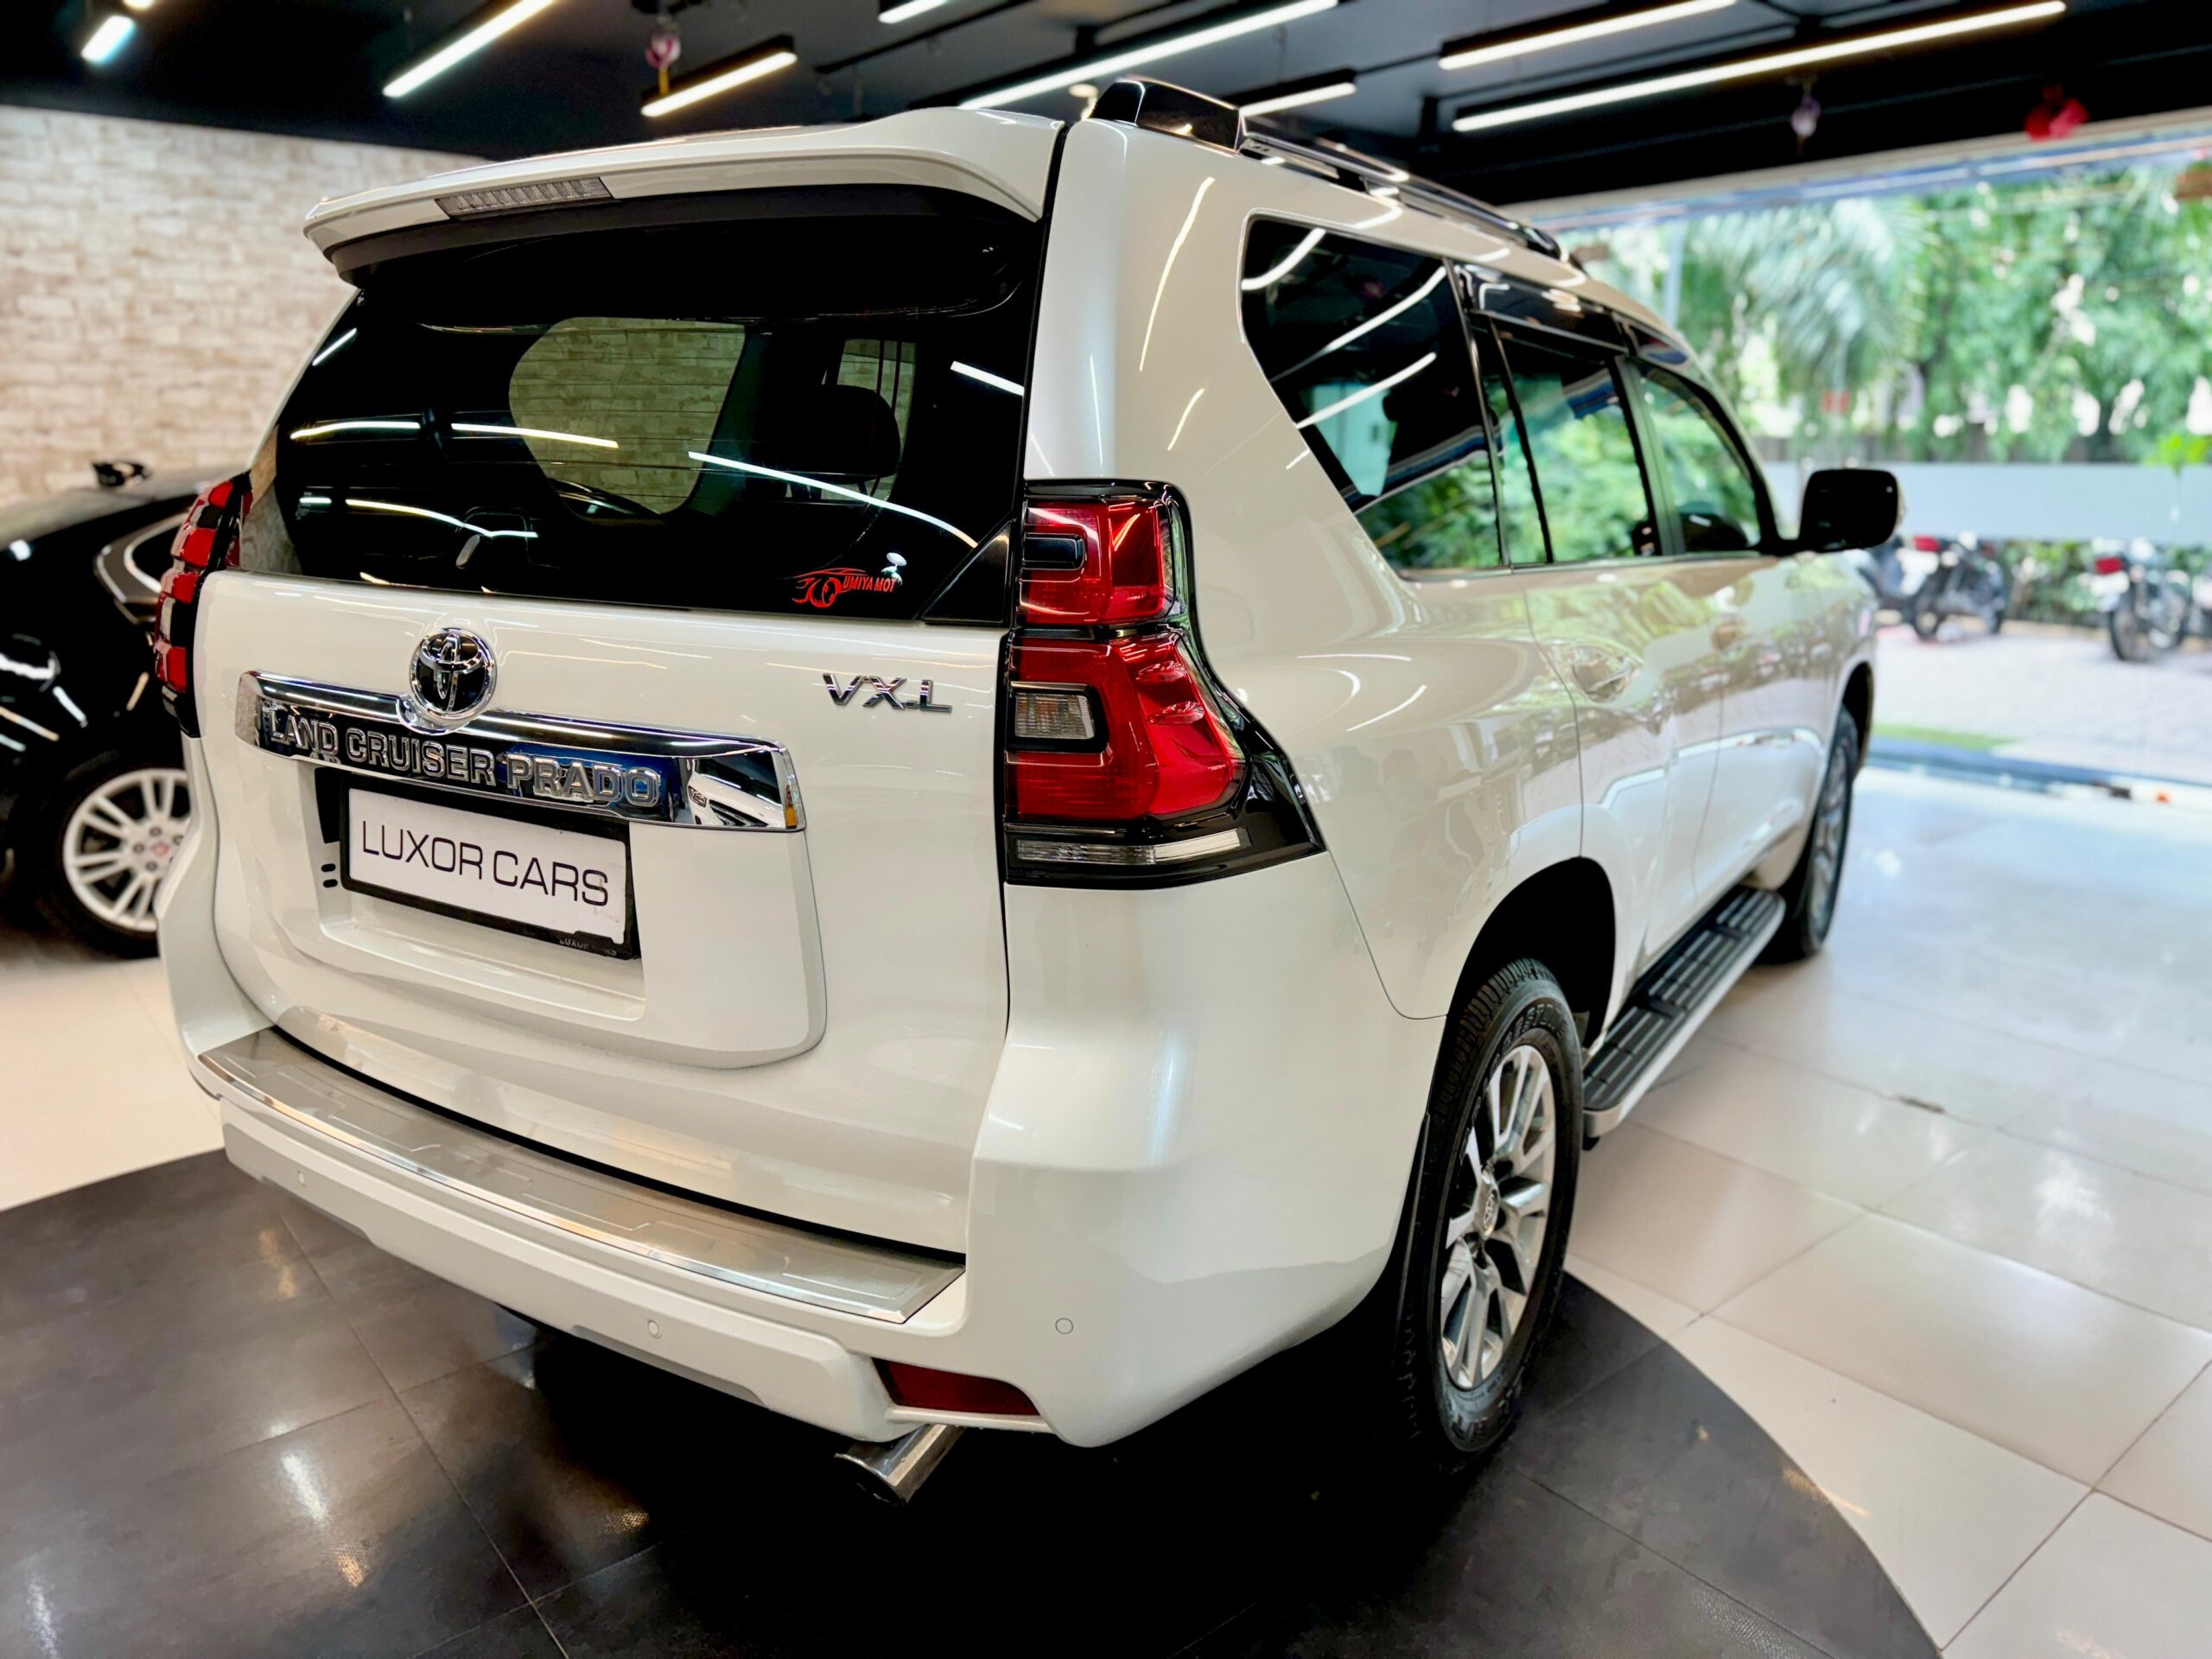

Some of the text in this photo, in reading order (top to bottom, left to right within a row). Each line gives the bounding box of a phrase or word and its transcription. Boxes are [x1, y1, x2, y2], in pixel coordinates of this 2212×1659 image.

[842, 575, 874, 591] UMIYA
[270, 709, 661, 807] LAND CRUISER PRADO
[362, 820, 609, 907] LUXOR CARS
